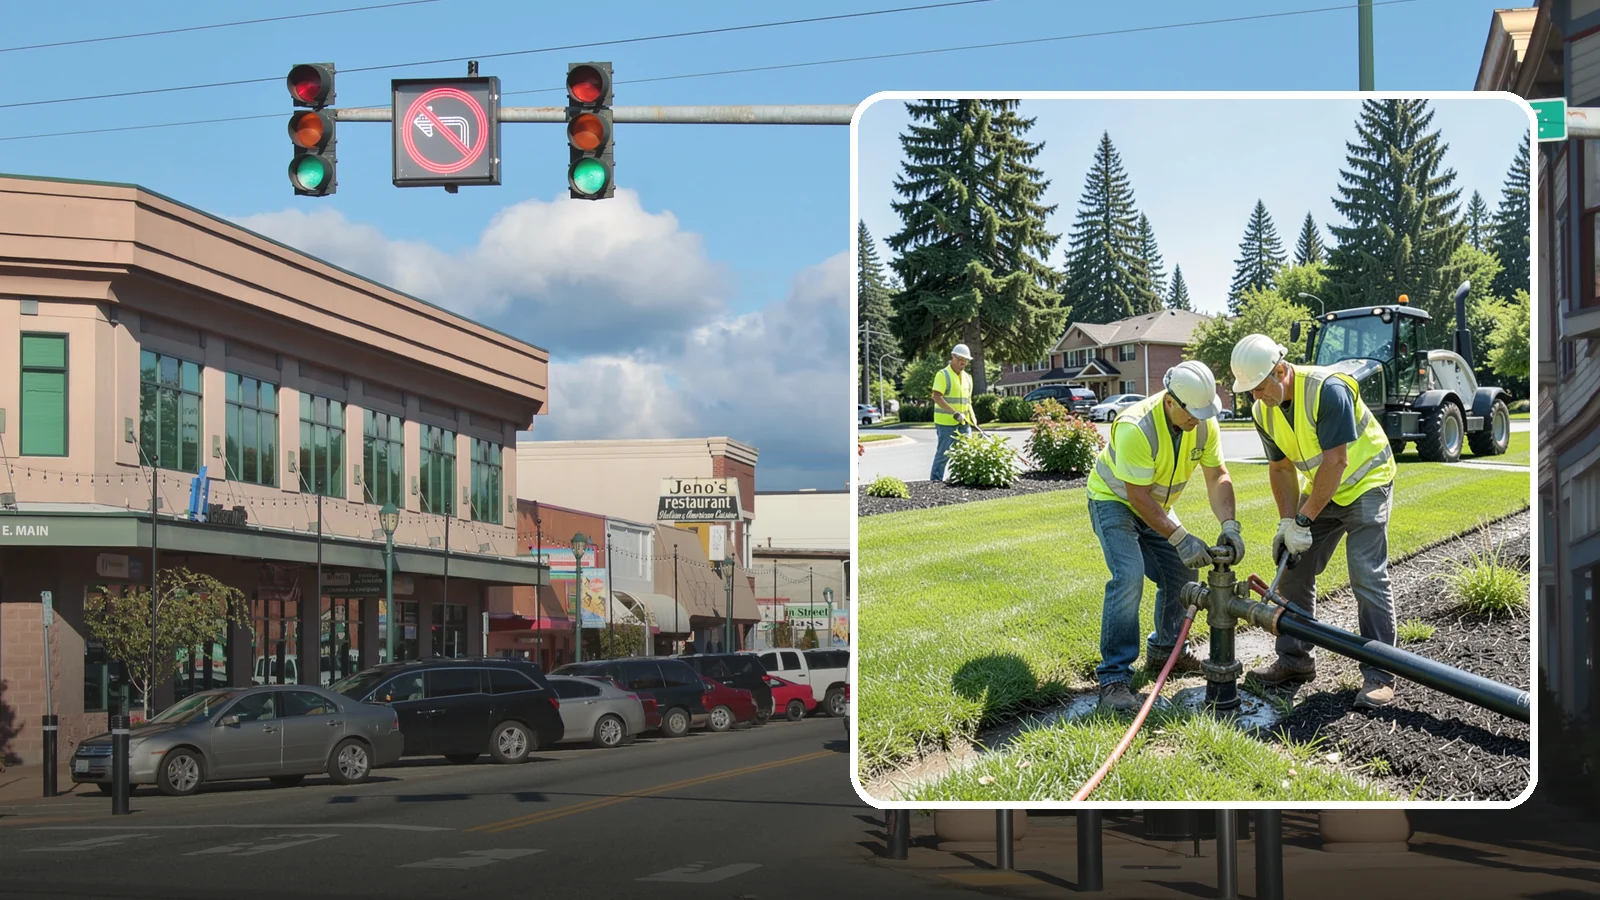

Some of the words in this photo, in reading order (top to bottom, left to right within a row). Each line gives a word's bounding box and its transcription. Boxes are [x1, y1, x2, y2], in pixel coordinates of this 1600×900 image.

[670, 480, 727, 494] Jeno's
[665, 496, 730, 509] restaurant
[659, 510, 682, 519] Italian
[686, 510, 714, 519] American
[715, 509, 737, 519] Cuisine
[2, 525, 13, 536] E.
[16, 525, 49, 536] MAIN
[797, 607, 828, 617] Street
